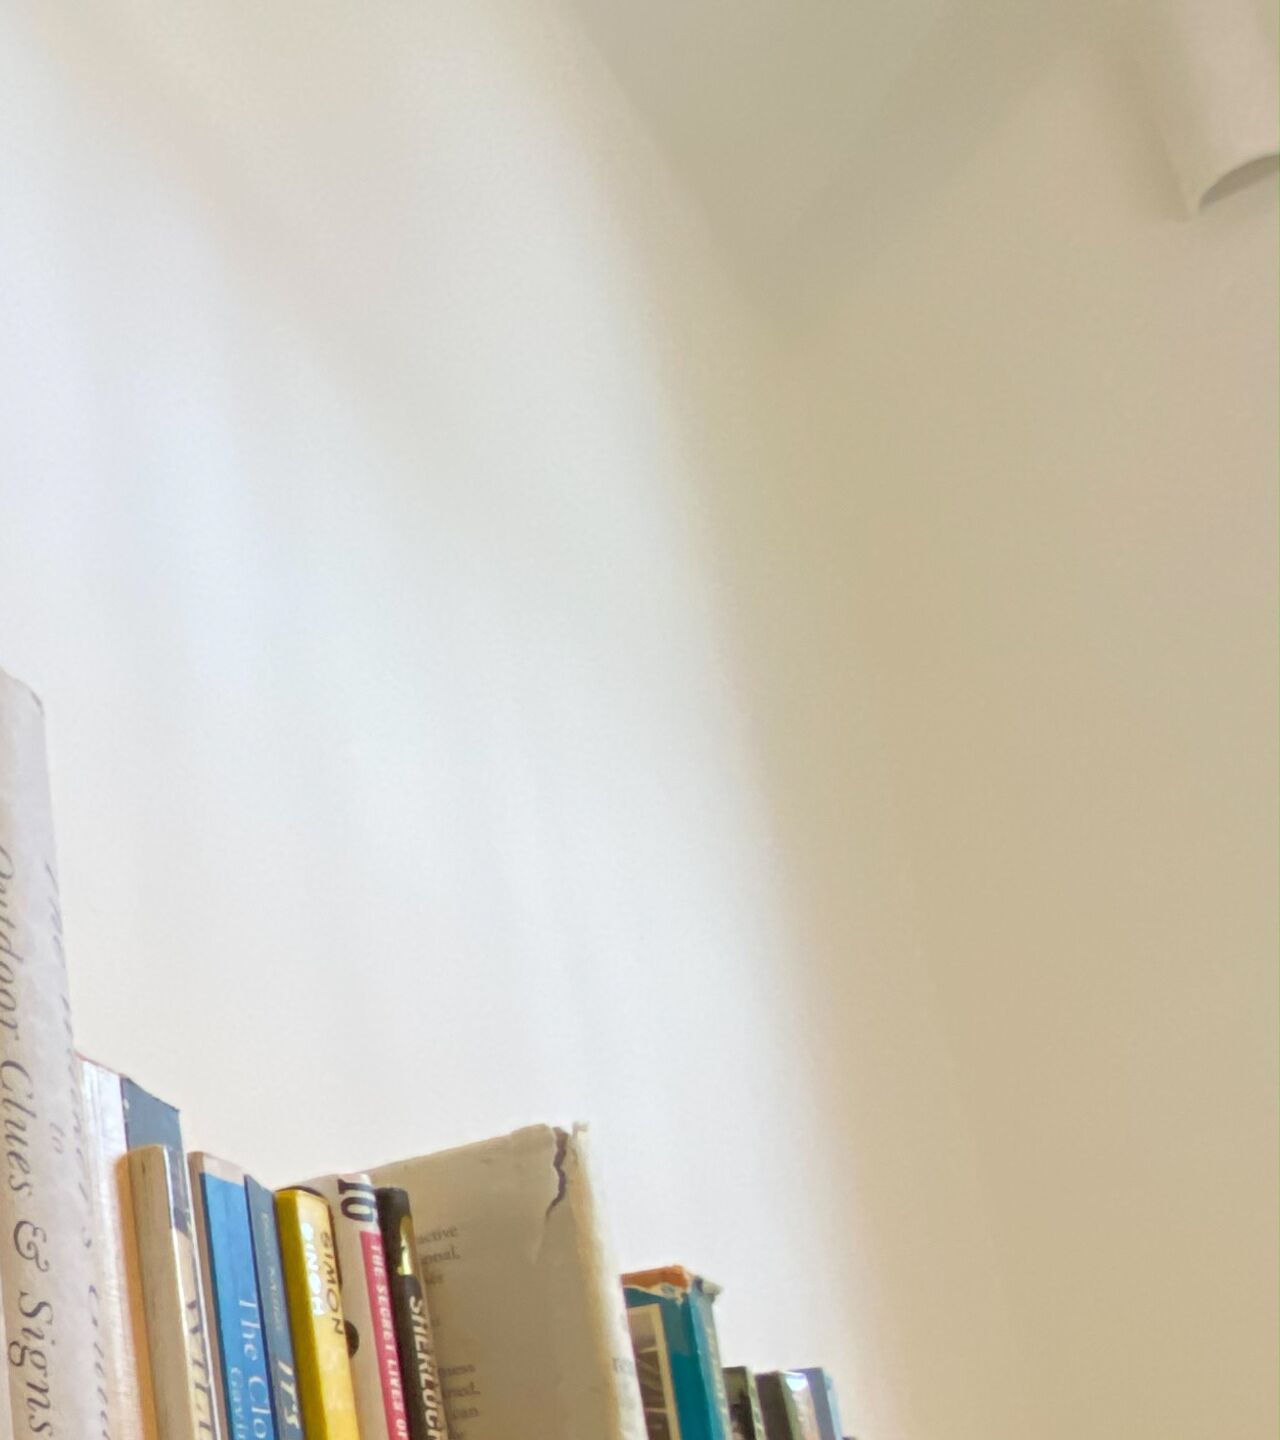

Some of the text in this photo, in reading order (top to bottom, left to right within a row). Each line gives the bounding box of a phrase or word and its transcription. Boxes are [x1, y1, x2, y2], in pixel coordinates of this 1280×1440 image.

[0, 1059, 38, 1195] Clues
[13, 1219, 49, 1273] &
[319, 1232, 345, 1336] SIMON
[8, 1291, 56, 1439] Signs
[239, 1299, 261, 1361] The
[370, 1243, 409, 1440] THE SECRET LIVES OF
[277, 1360, 301, 1432] IT'S
